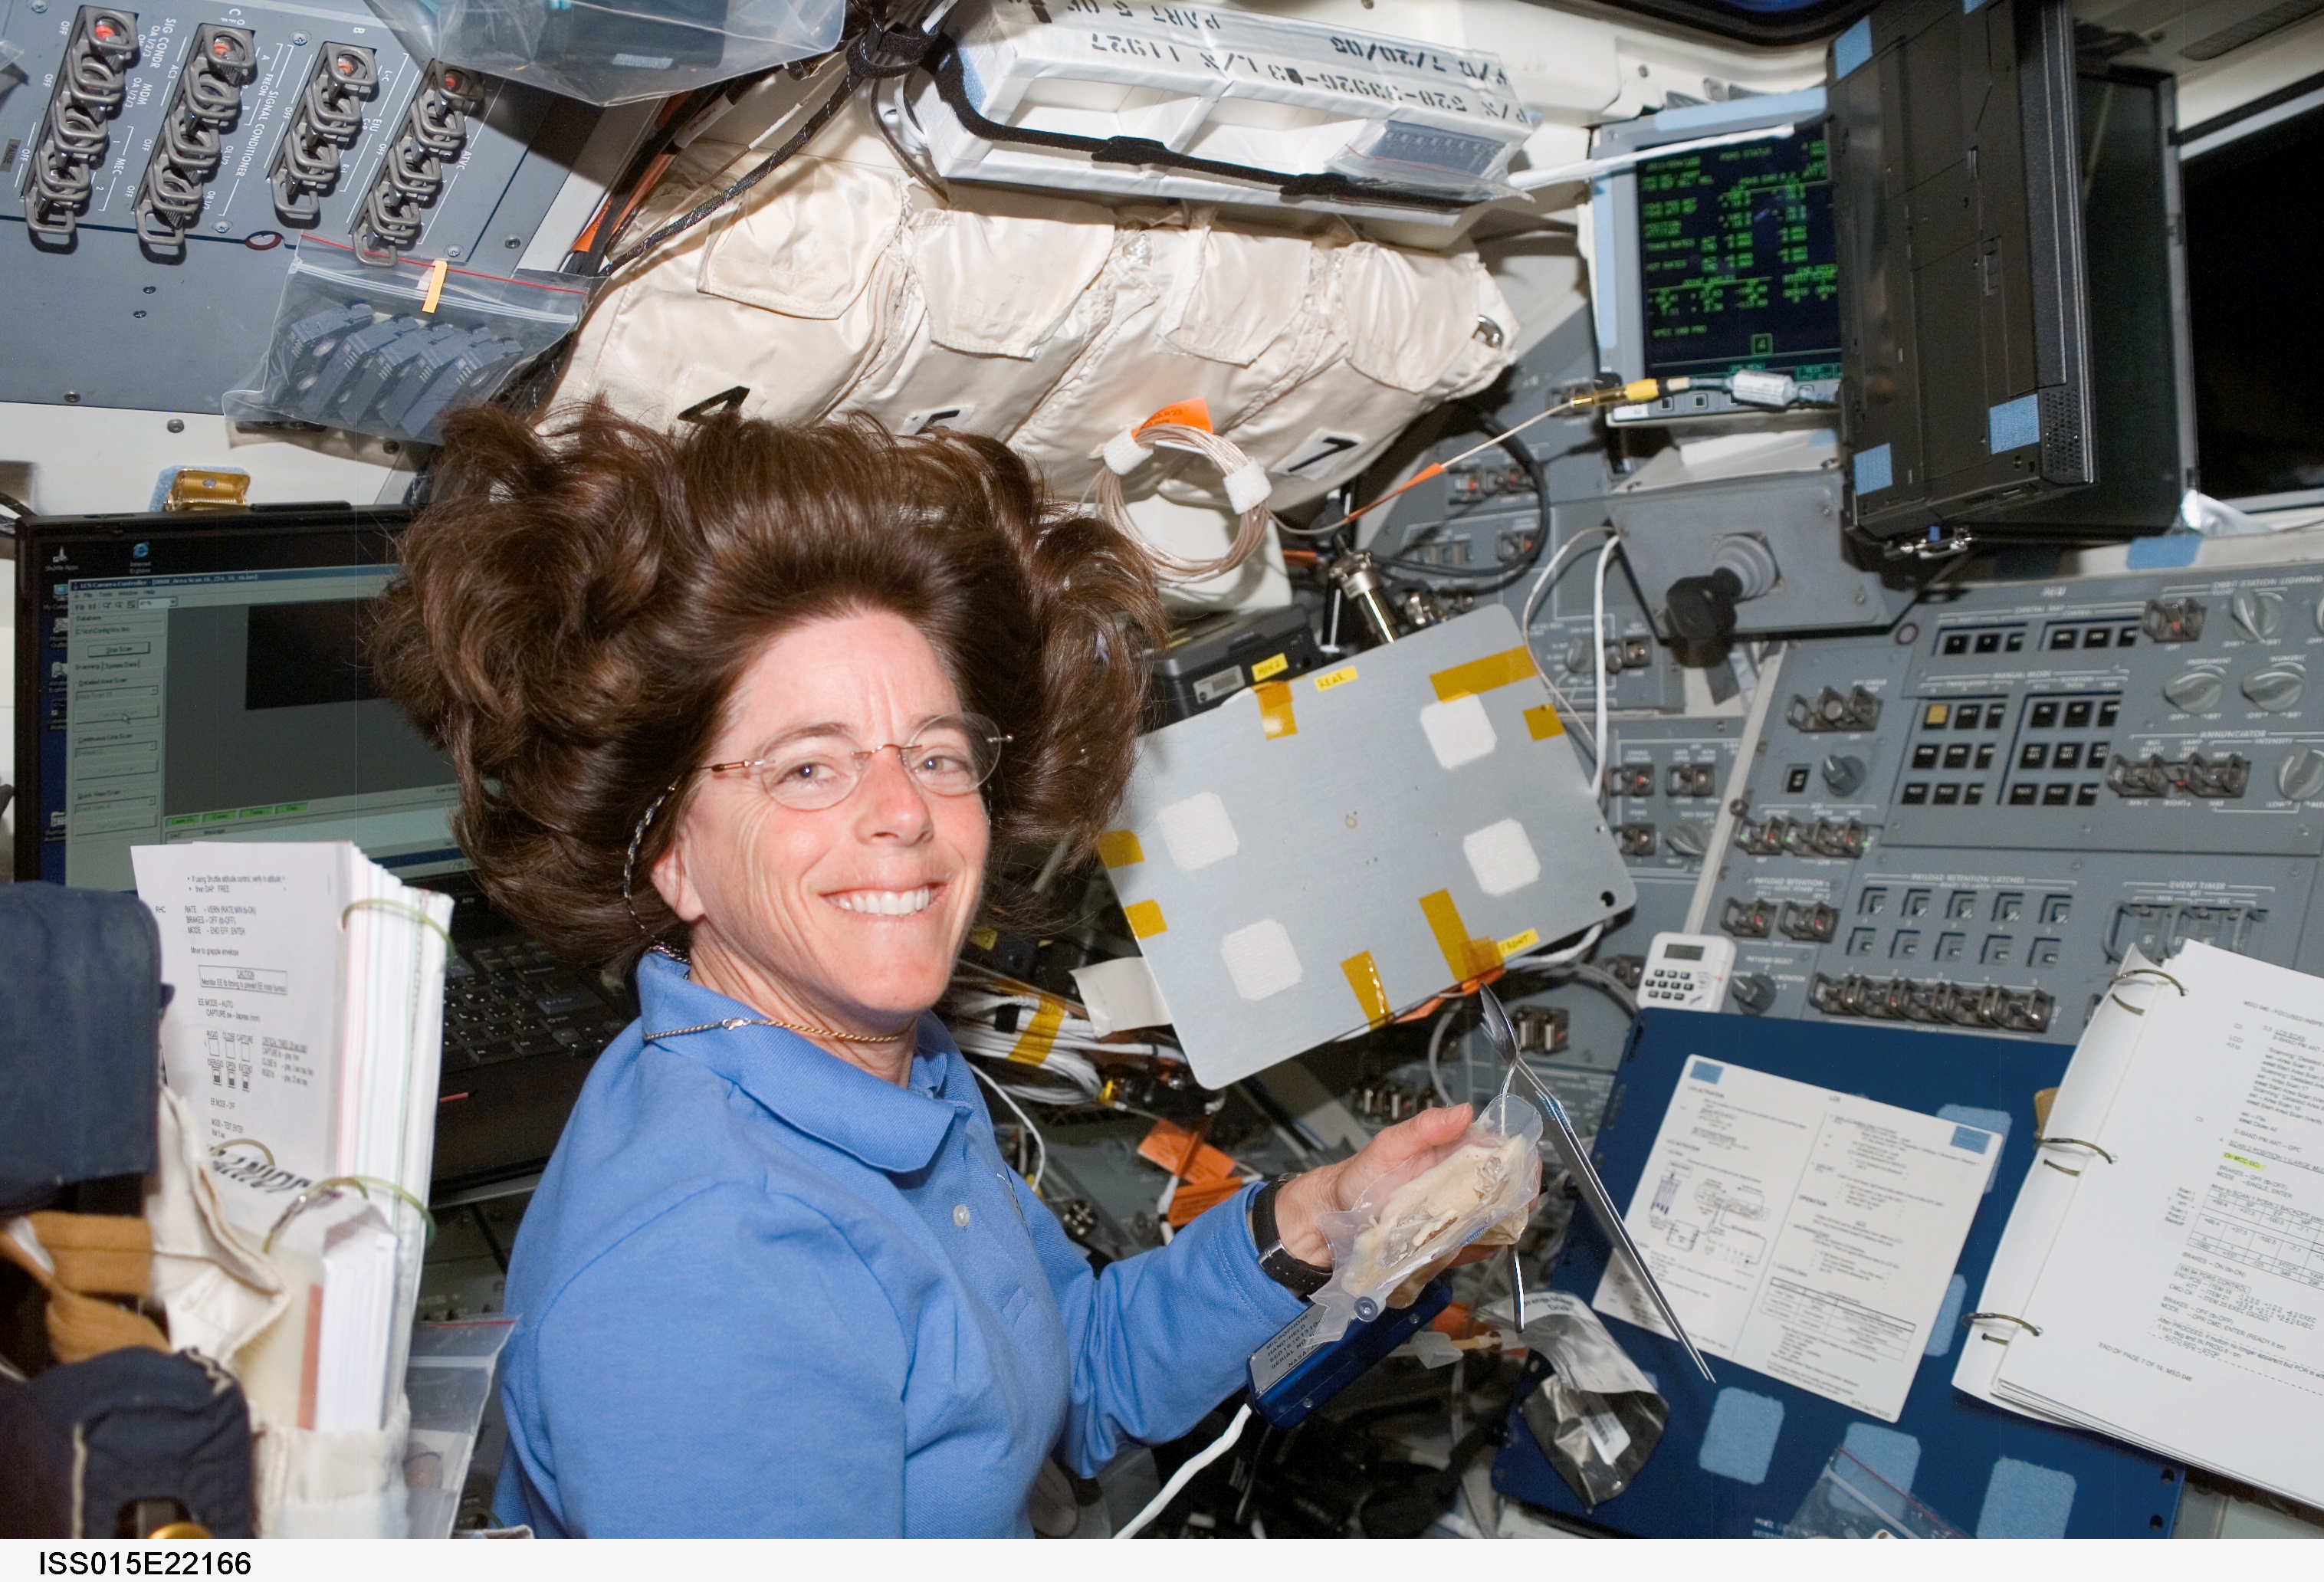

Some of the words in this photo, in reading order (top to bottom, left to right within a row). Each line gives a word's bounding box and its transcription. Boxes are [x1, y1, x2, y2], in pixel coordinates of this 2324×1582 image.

[58, 21, 71, 35] OFF
[162, 18, 176, 34] SIG
[149, 37, 169, 69] CONDR
[167, 64, 179, 80] AC3
[42, 74, 54, 88] OFF
[258, 73, 274, 97] FREON
[136, 83, 153, 106] MDM
[257, 90, 279, 122] SIGNAL
[282, 107, 293, 120] OFF
[369, 117, 382, 133] EIU
[142, 139, 152, 152] OFF
[235, 122, 266, 178] CONDITIONER
[376, 143, 387, 156] OFF
[19, 149, 31, 162] OFF
[456, 150, 473, 170] ATVC
[112, 157, 126, 175] MEC
[125, 185, 136, 198] OFF
